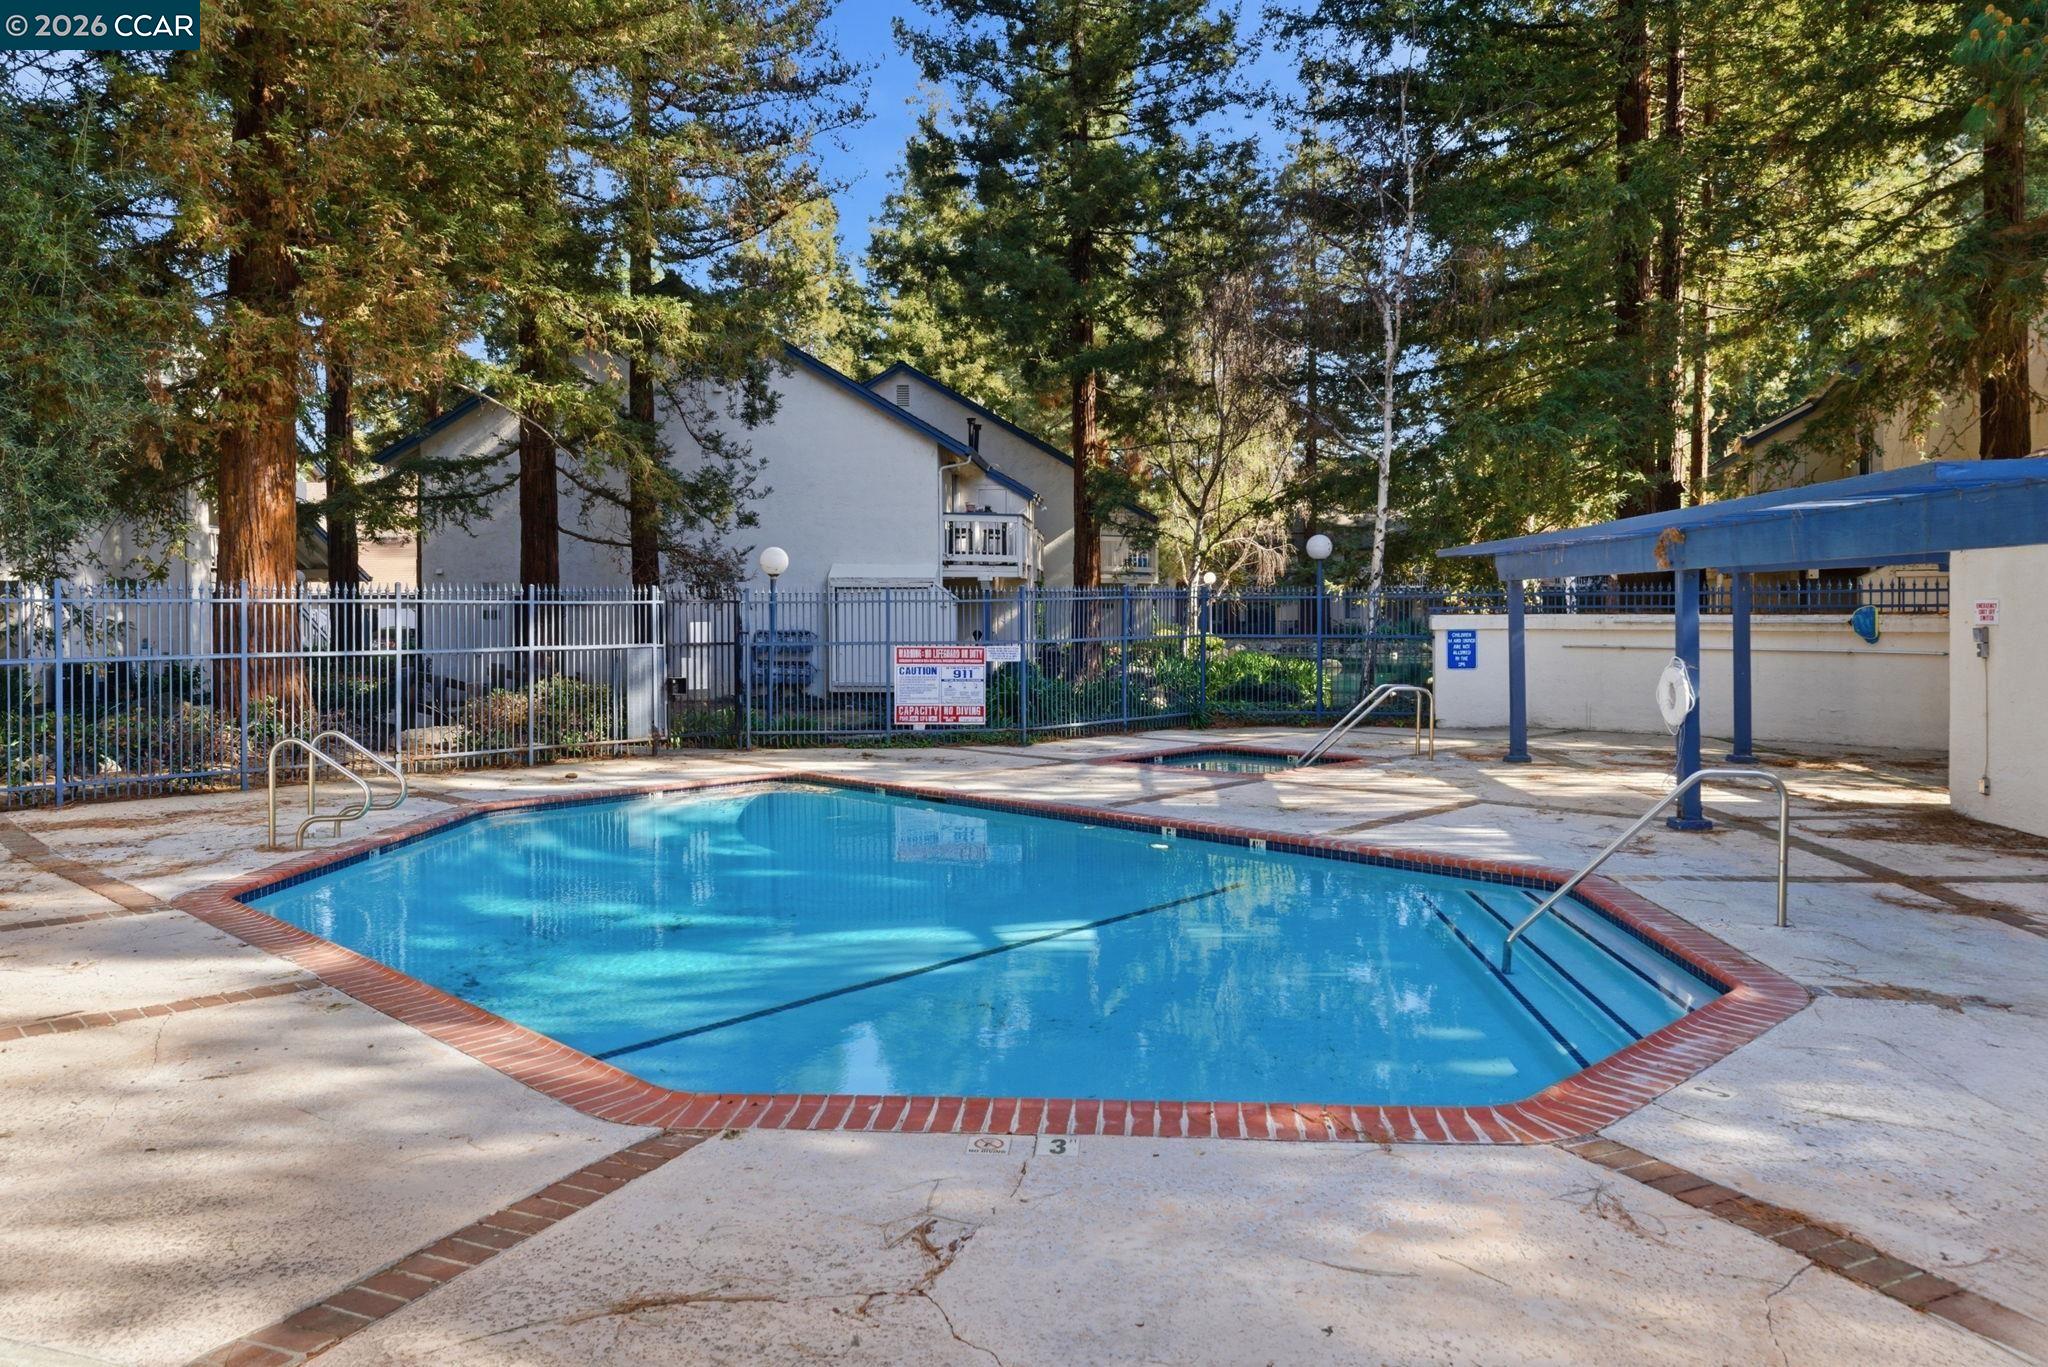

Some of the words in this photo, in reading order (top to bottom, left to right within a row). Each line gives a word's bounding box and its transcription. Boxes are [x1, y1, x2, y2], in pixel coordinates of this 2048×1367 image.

[925, 649, 932, 659] NO
[933, 649, 961, 659] LIFEGUARD
[962, 649, 969, 659] ON
[969, 649, 983, 659] DUTY
[899, 666, 938, 676] CAUTION
[953, 669, 973, 679] 911
[898, 706, 939, 716] CAPACITY
[943, 706, 954, 716] NO
[956, 706, 981, 716] DIVING
[1049, 1138, 1067, 1154] 3
